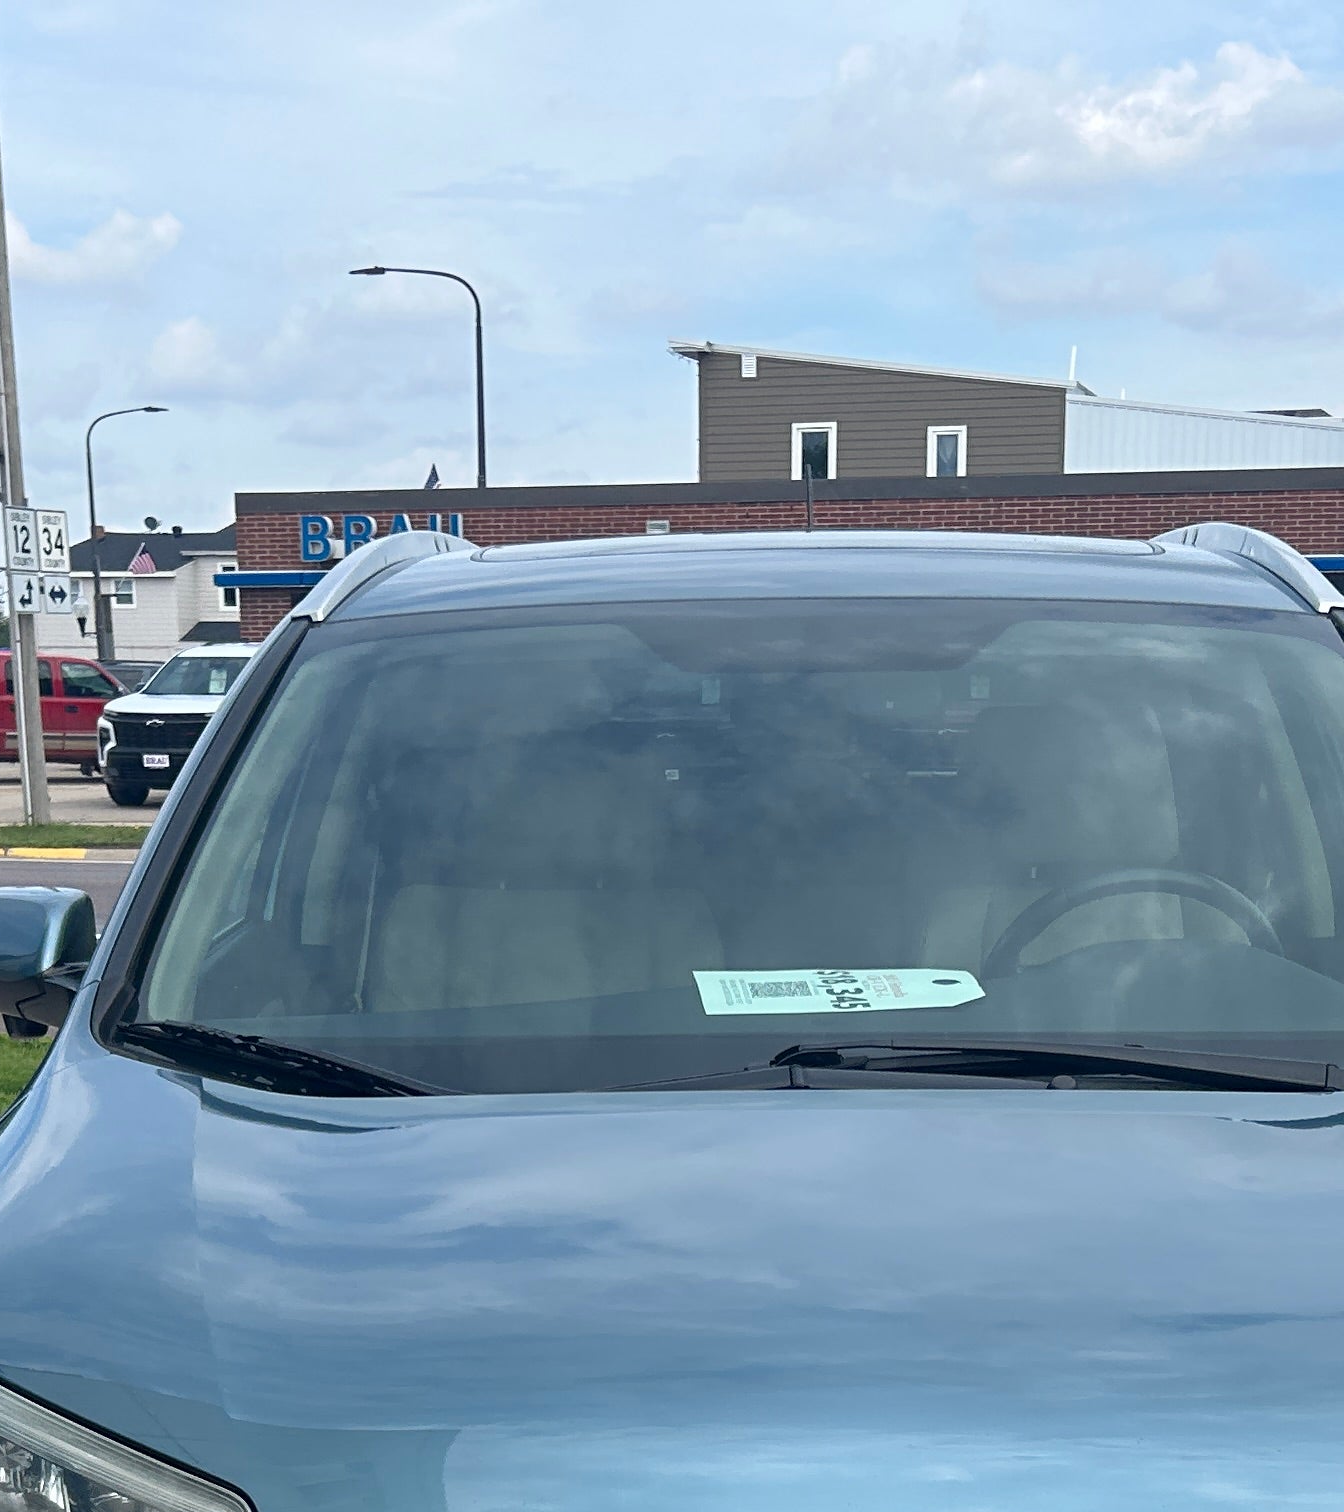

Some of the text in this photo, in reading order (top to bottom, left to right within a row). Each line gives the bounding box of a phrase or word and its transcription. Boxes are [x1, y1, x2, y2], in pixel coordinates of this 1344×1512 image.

[13, 525, 31, 554] 12
[42, 527, 64, 556] 34
[816, 970, 872, 1009] $18,345
